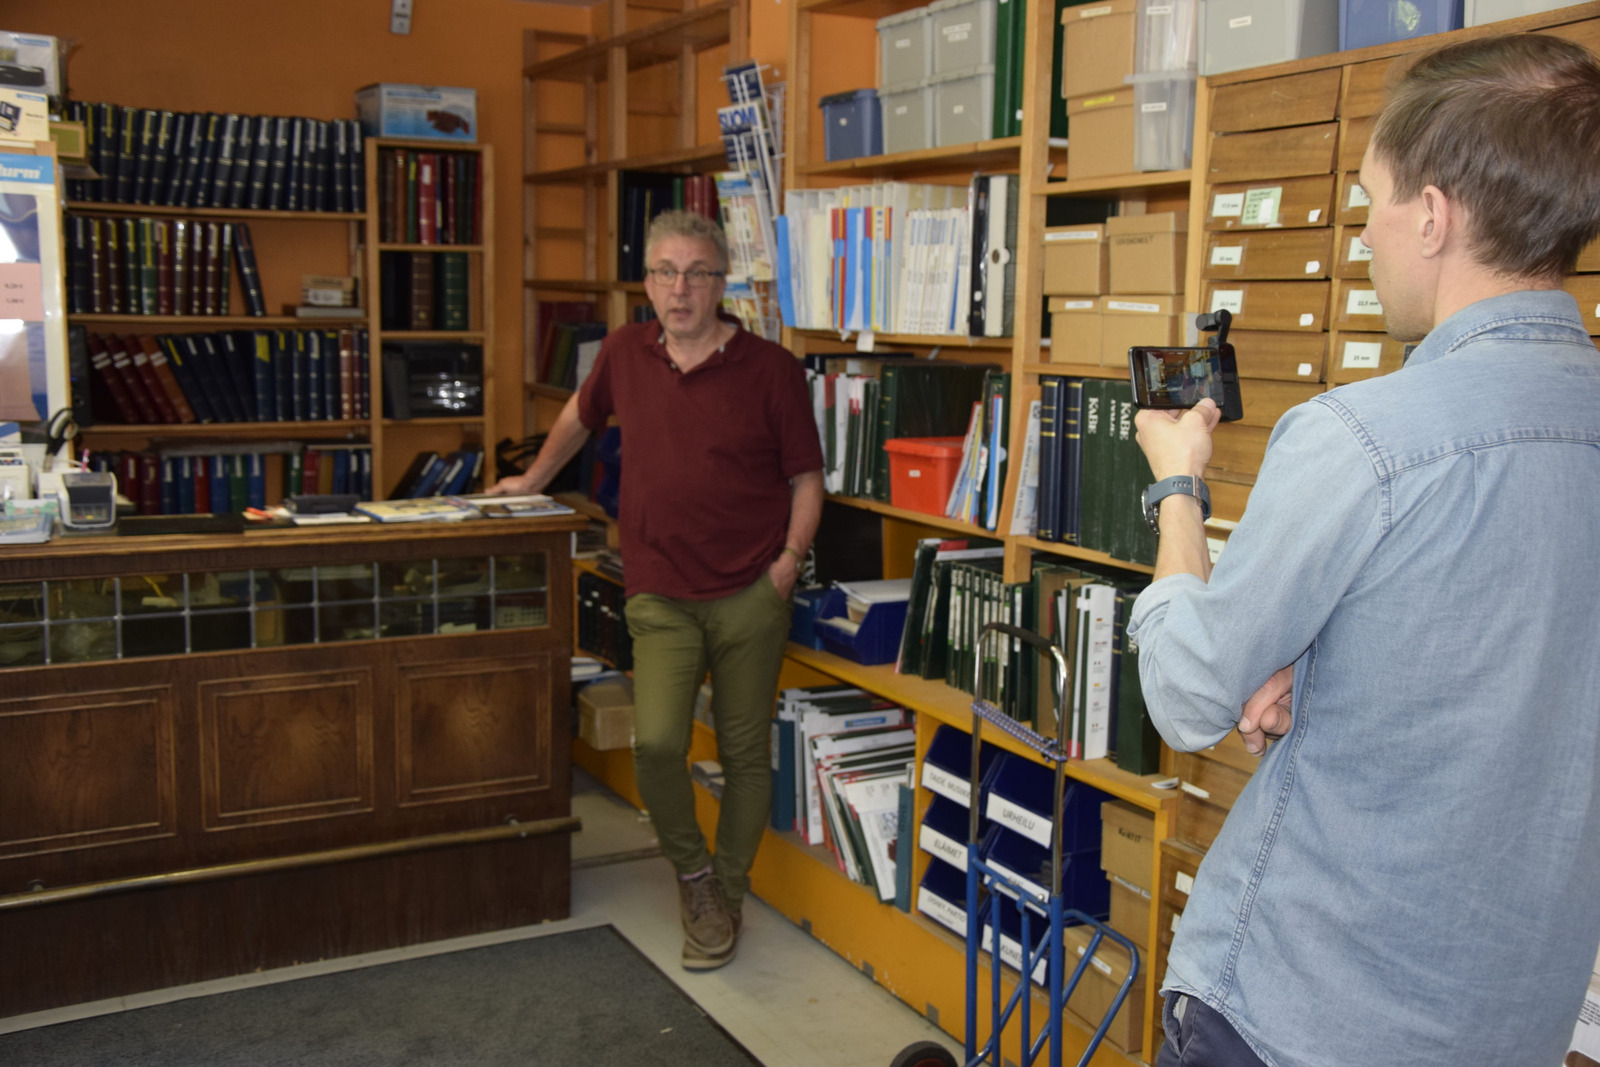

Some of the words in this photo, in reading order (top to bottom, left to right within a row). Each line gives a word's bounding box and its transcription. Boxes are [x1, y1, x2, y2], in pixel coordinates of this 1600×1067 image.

[1088, 397, 1099, 434] KABE
[1120, 402, 1131, 441] KABE
[1002, 808, 1035, 830] URHEILU
[934, 838, 962, 859] ELÄIMET
